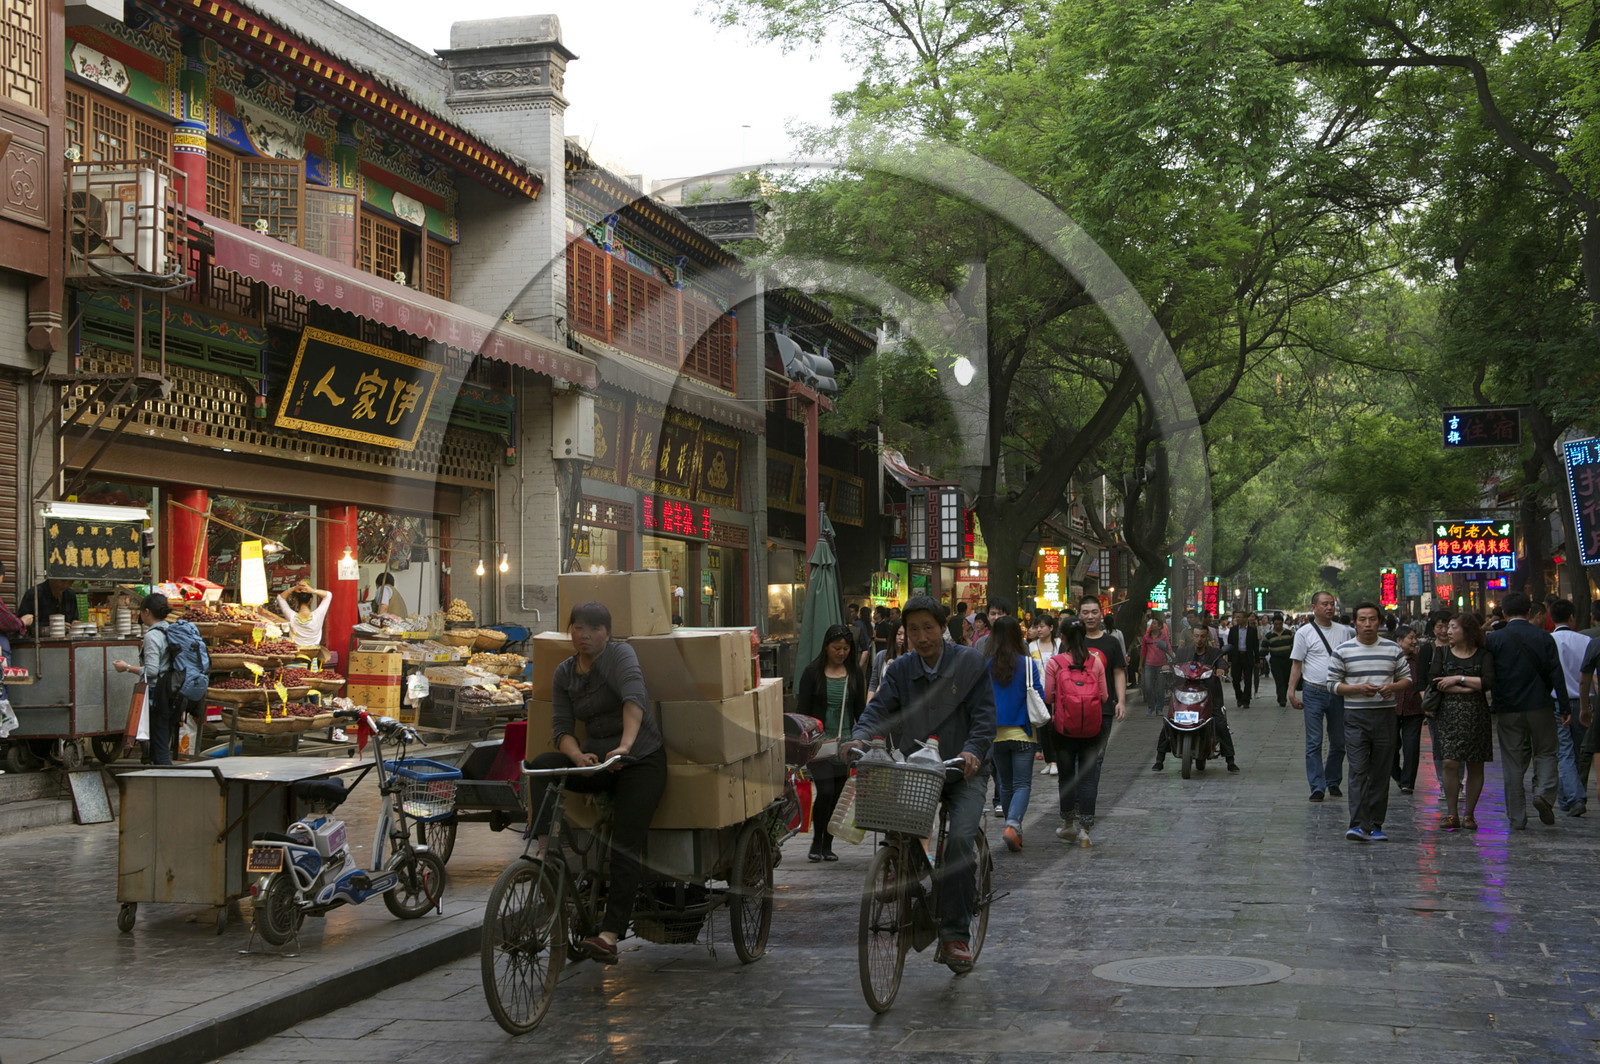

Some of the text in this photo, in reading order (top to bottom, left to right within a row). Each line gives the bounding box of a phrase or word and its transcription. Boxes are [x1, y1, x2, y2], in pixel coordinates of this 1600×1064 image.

[371, 295, 505, 353] 伊家人土特产
[1448, 415, 1461, 444] 吉祥
[1463, 417, 1515, 441] 住宿
[1448, 524, 1499, 539] 何老八
[1437, 538, 1511, 555] 特色砂锅米线
[1438, 554, 1512, 570] 纯手工牛肉面
